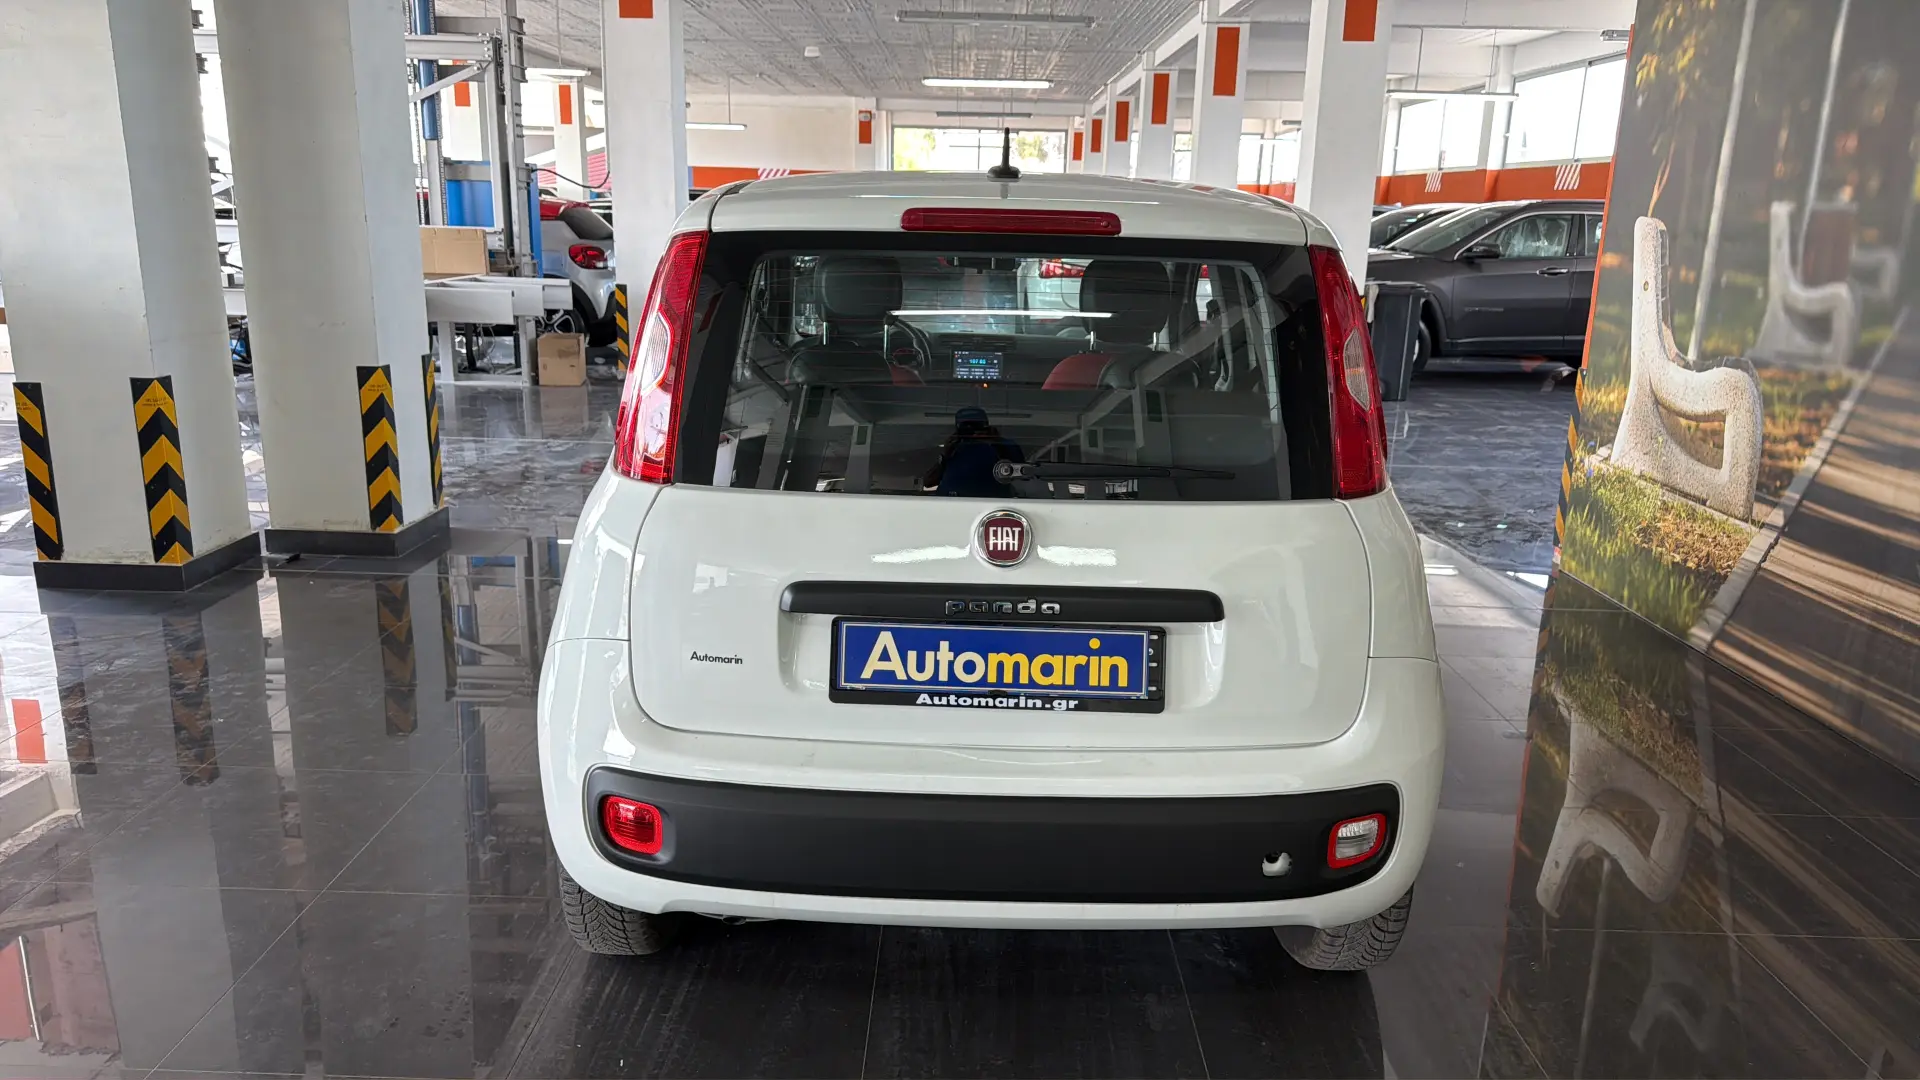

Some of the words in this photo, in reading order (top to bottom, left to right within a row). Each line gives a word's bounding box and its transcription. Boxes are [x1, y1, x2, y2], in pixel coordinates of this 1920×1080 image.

[989, 526, 1021, 551] FIAT
[945, 599, 1060, 615] panda
[690, 651, 743, 664] Automarin
[860, 630, 1127, 687] Automarin
[916, 693, 1079, 711] Automarin.gr
